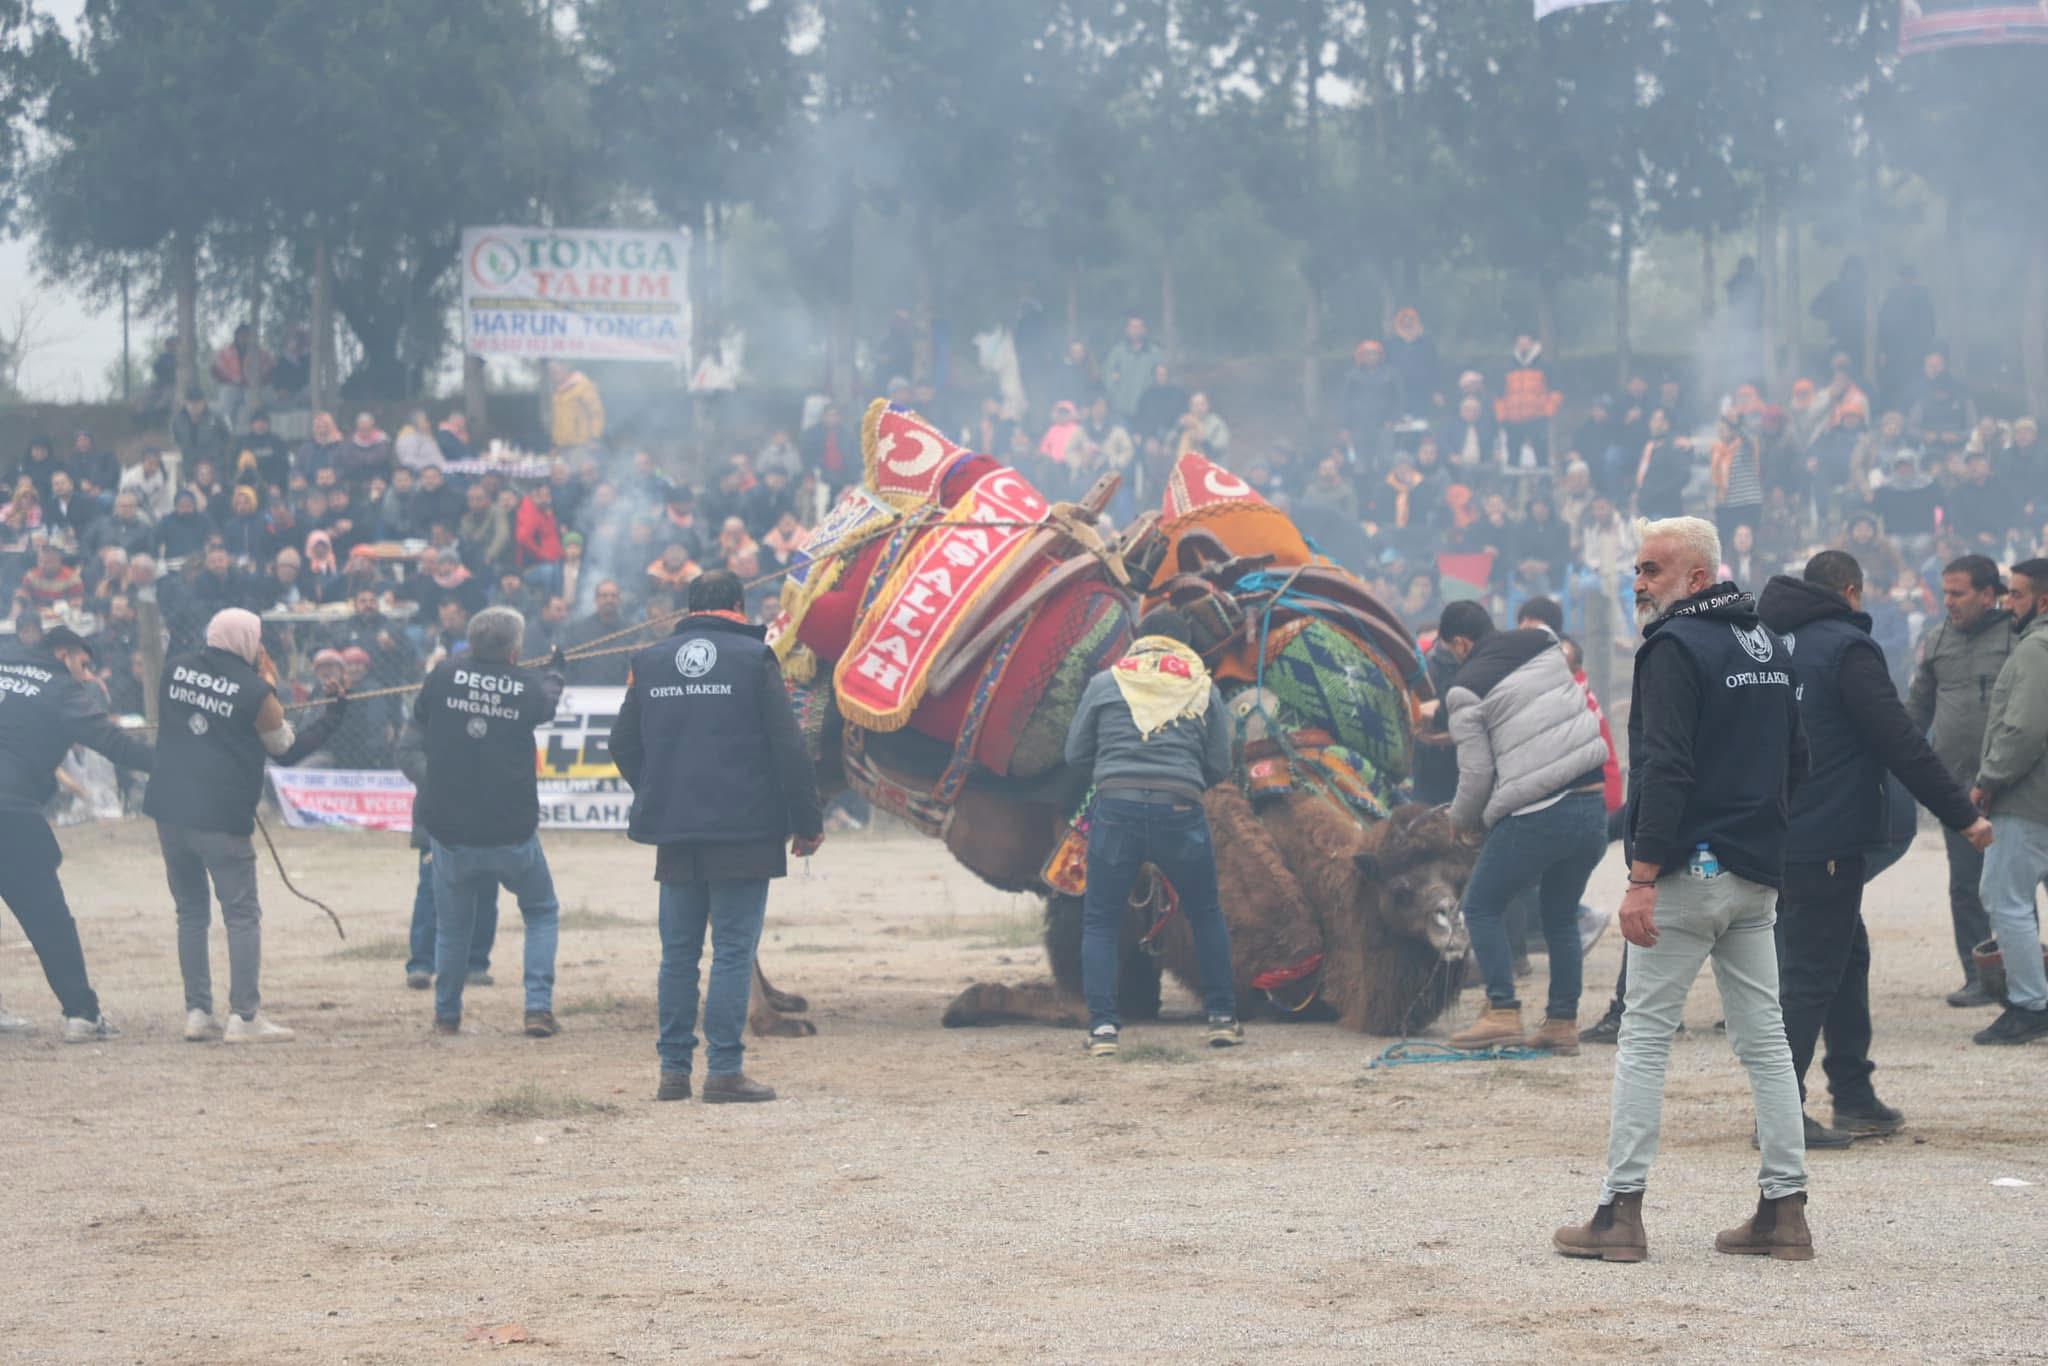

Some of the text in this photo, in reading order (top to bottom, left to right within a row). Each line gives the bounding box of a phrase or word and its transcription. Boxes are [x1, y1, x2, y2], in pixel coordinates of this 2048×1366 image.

[522, 237, 678, 271] TONGA
[533, 271, 671, 297] TARIM
[473, 312, 677, 338] HARUN TONGA
[857, 500, 1020, 690] MAŞALLAH
[172, 664, 241, 697] DEGÜF
[453, 668, 525, 697] DEGÜF
[650, 683, 733, 698] ORTA HAKEM
[1726, 671, 1759, 688] ORTA
[168, 684, 235, 718] URGANCI
[446, 696, 520, 721] URGANCI
